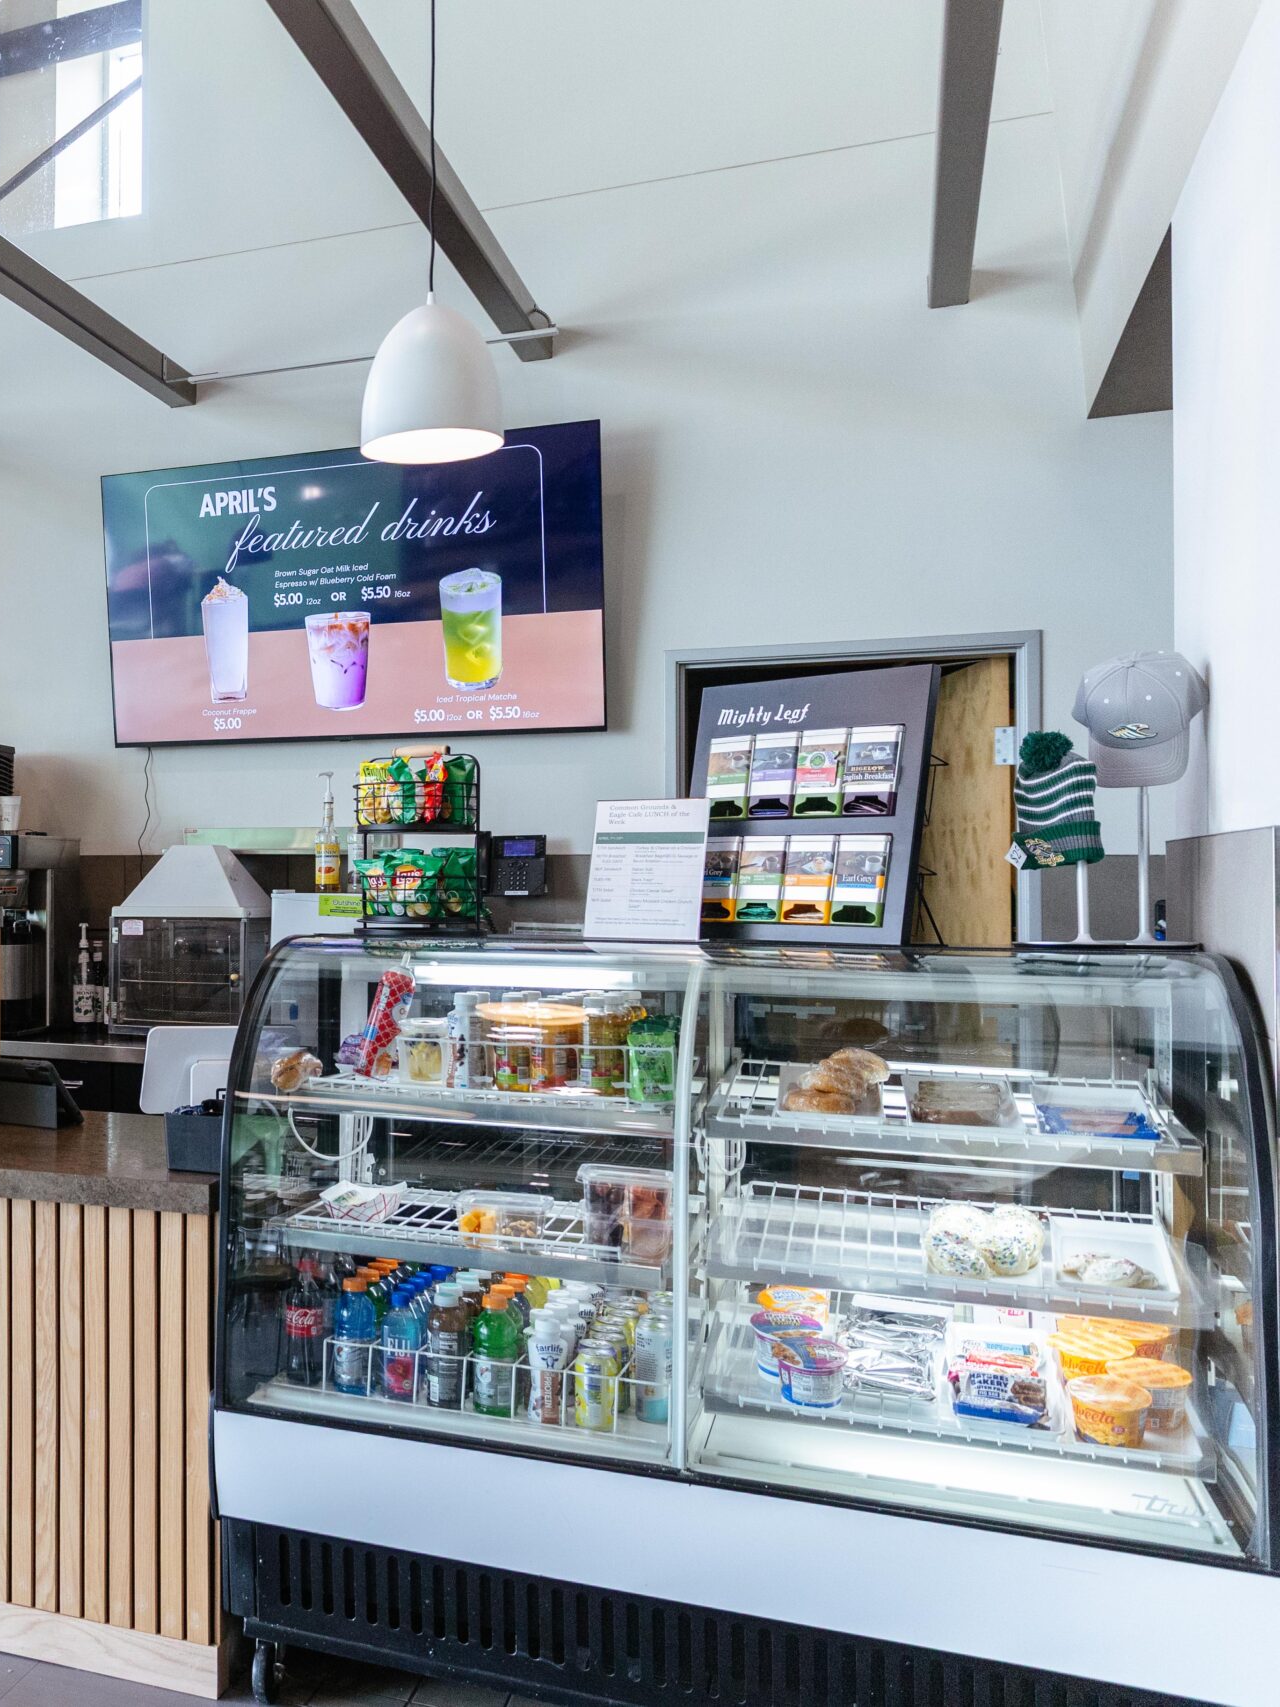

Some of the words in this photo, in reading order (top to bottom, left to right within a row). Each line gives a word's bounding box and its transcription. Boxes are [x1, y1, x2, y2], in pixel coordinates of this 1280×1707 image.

[199, 486, 277, 518] APRIL'S
[225, 501, 380, 573] featured
[381, 491, 497, 542] drinks
[274, 570, 297, 578] Brown
[298, 567, 319, 577] Sugar
[320, 566, 334, 574] Oat
[335, 564, 350, 573] Milk
[352, 563, 369, 571] Iced
[274, 580, 308, 590] Espresso
[309, 578, 319, 586] w/
[319, 576, 356, 587] Blueberry
[356, 574, 374, 582] Cold
[375, 572, 397, 581] Foam
[273, 592, 303, 608] $5.00
[330, 592, 347, 602] OR
[361, 585, 392, 602] $5.50
[394, 590, 411, 598] 16oz
[455, 694, 486, 704] Tropical
[487, 692, 518, 701] Matcha
[202, 708, 231, 716] Coconut
[414, 708, 445, 724] $5.00
[466, 710, 483, 720] OR
[489, 706, 521, 721] $5.50
[718, 705, 772, 728] Mighty
[774, 703, 810, 722] Leaf
[213, 717, 241, 731] $5.00
[864, 772, 894, 780] Breakfast
[842, 873, 856, 882] Earl
[856, 874, 874, 883] Grey
[387, 1337, 411, 1357] FIJI
[535, 1344, 564, 1354] fairlife
[970, 1379, 1009, 1389] BAKERY
[544, 1376, 553, 1409] PROTEIN
